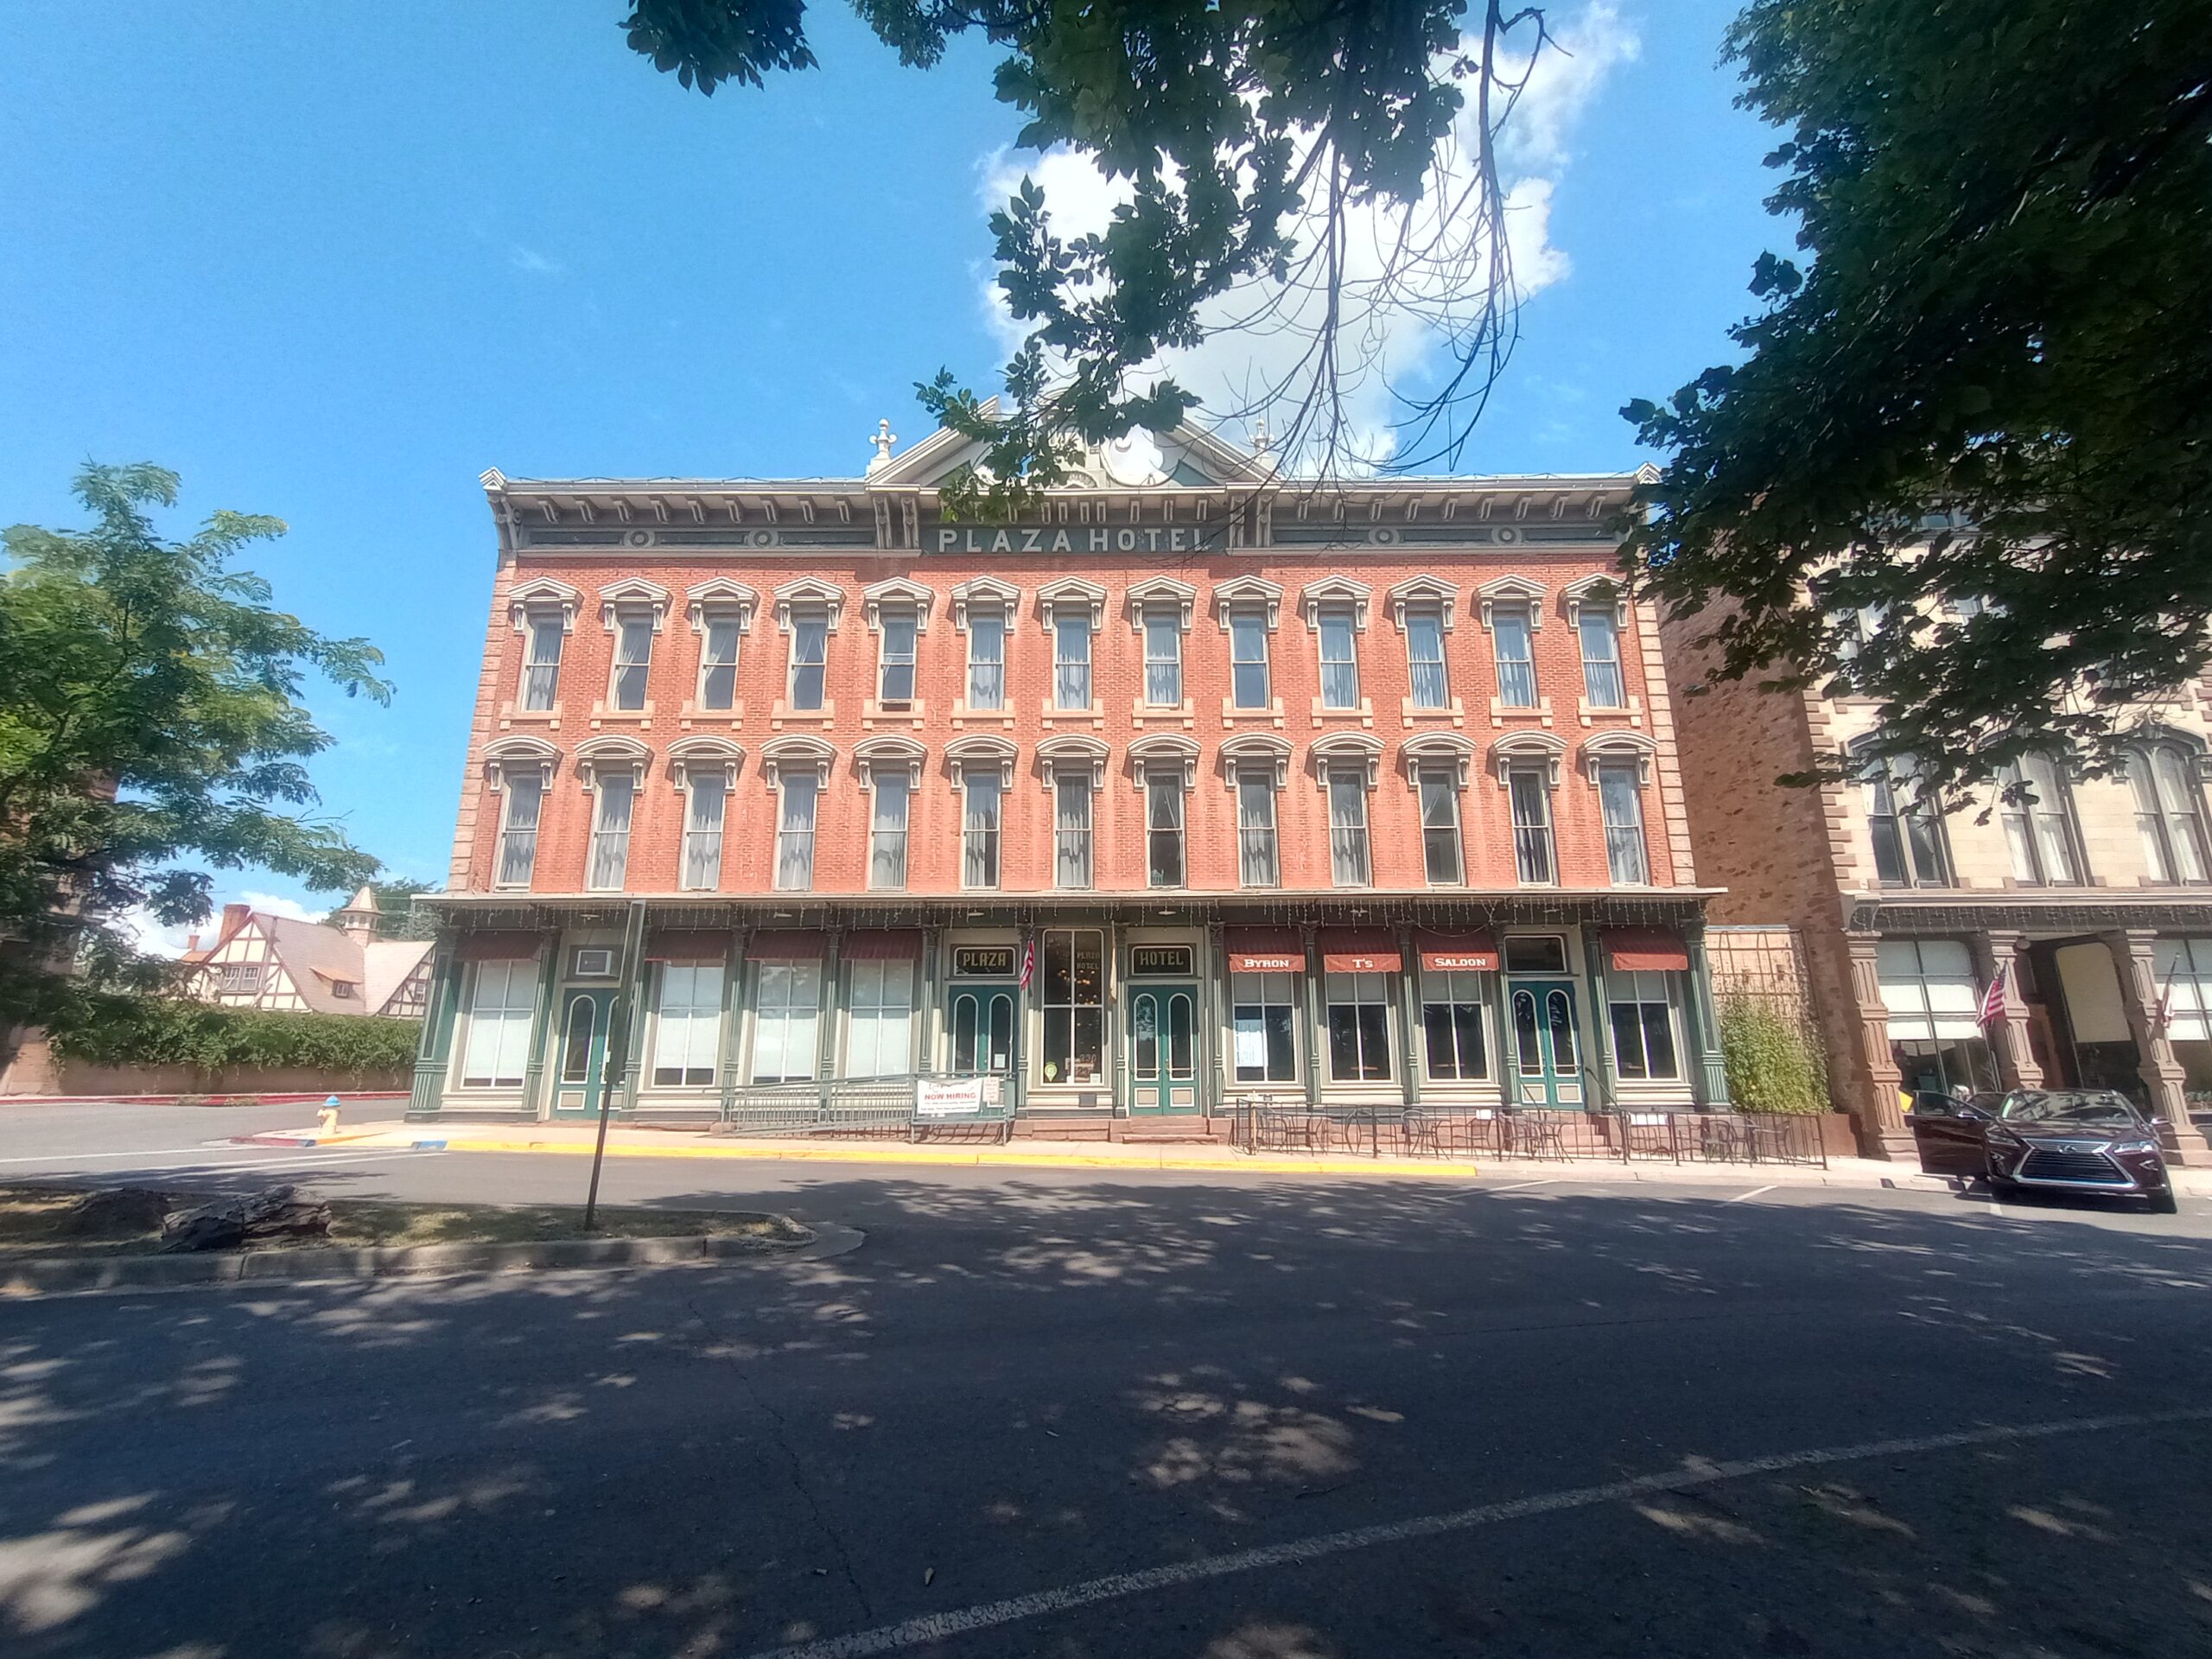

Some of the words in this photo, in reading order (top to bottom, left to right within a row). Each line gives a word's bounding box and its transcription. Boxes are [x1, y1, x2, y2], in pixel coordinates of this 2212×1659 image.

[938, 529, 1072, 553] PLAZA
[1089, 528, 1211, 552] HOTEL
[963, 952, 1007, 967] PLAZA
[1140, 951, 1185, 965] HOTEL
[1243, 958, 1290, 968] BYRON
[1434, 957, 1487, 967] SALOON
